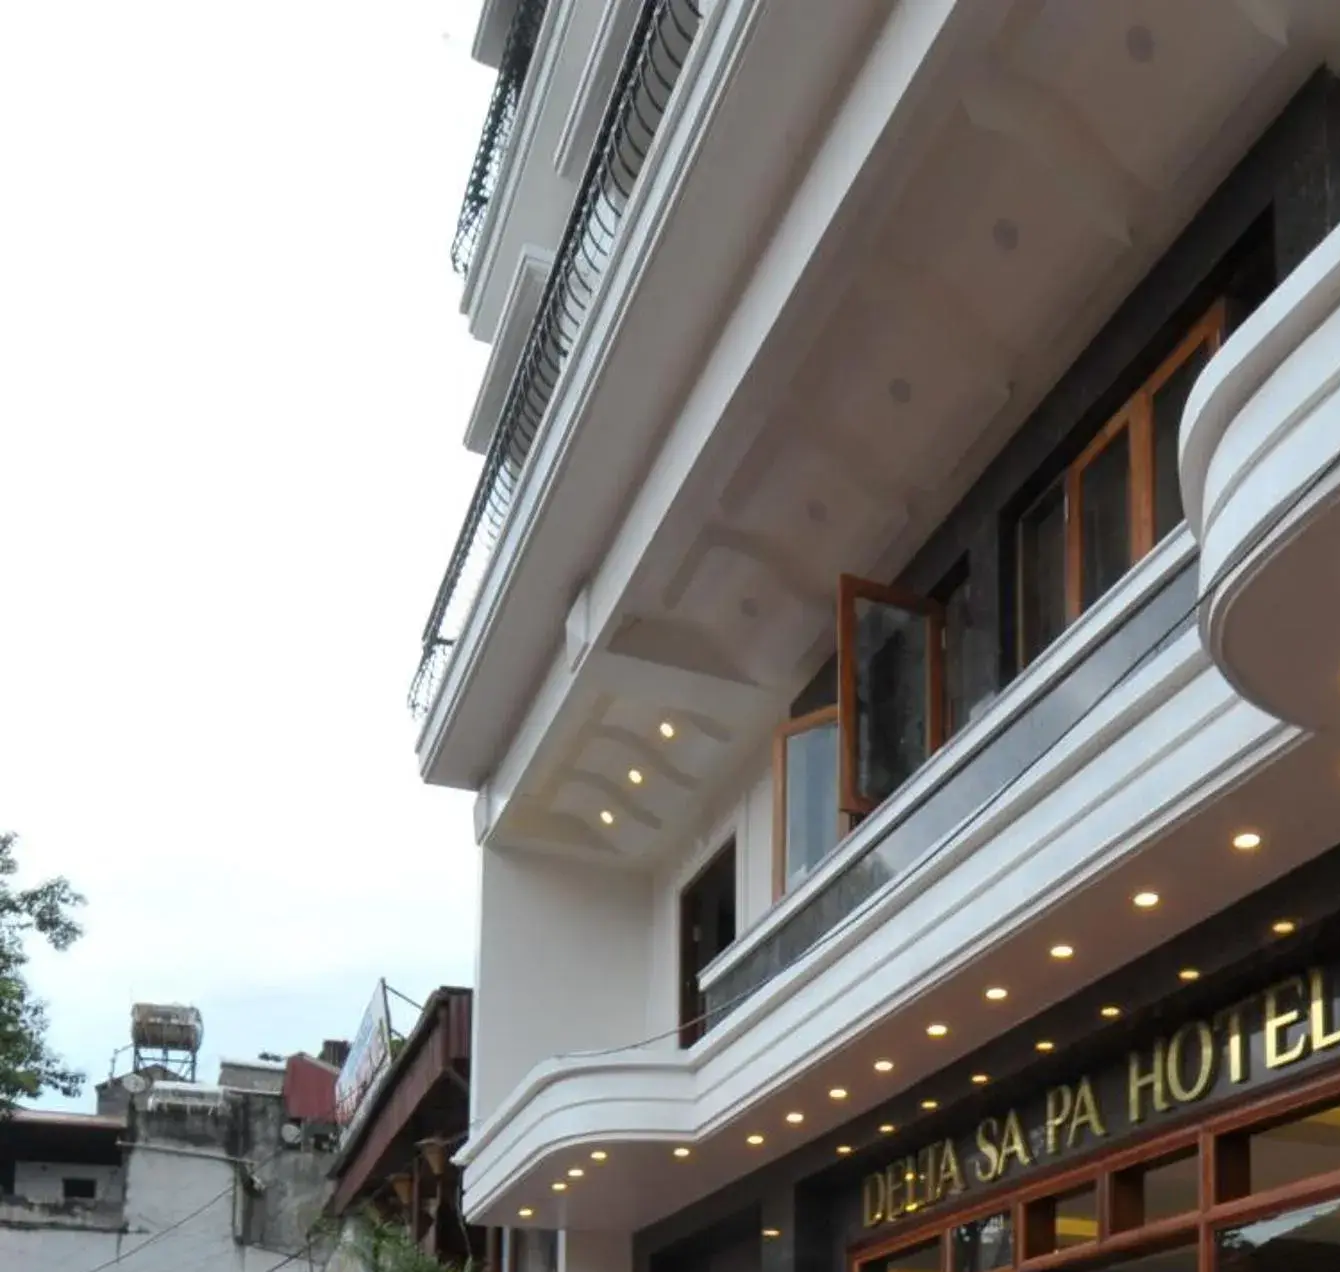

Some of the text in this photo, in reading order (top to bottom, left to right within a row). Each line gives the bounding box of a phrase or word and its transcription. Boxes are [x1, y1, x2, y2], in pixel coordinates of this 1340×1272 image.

[862, 1138, 966, 1228] DELTA
[974, 1108, 1033, 1183] SA
[1046, 1076, 1105, 1154] PA
